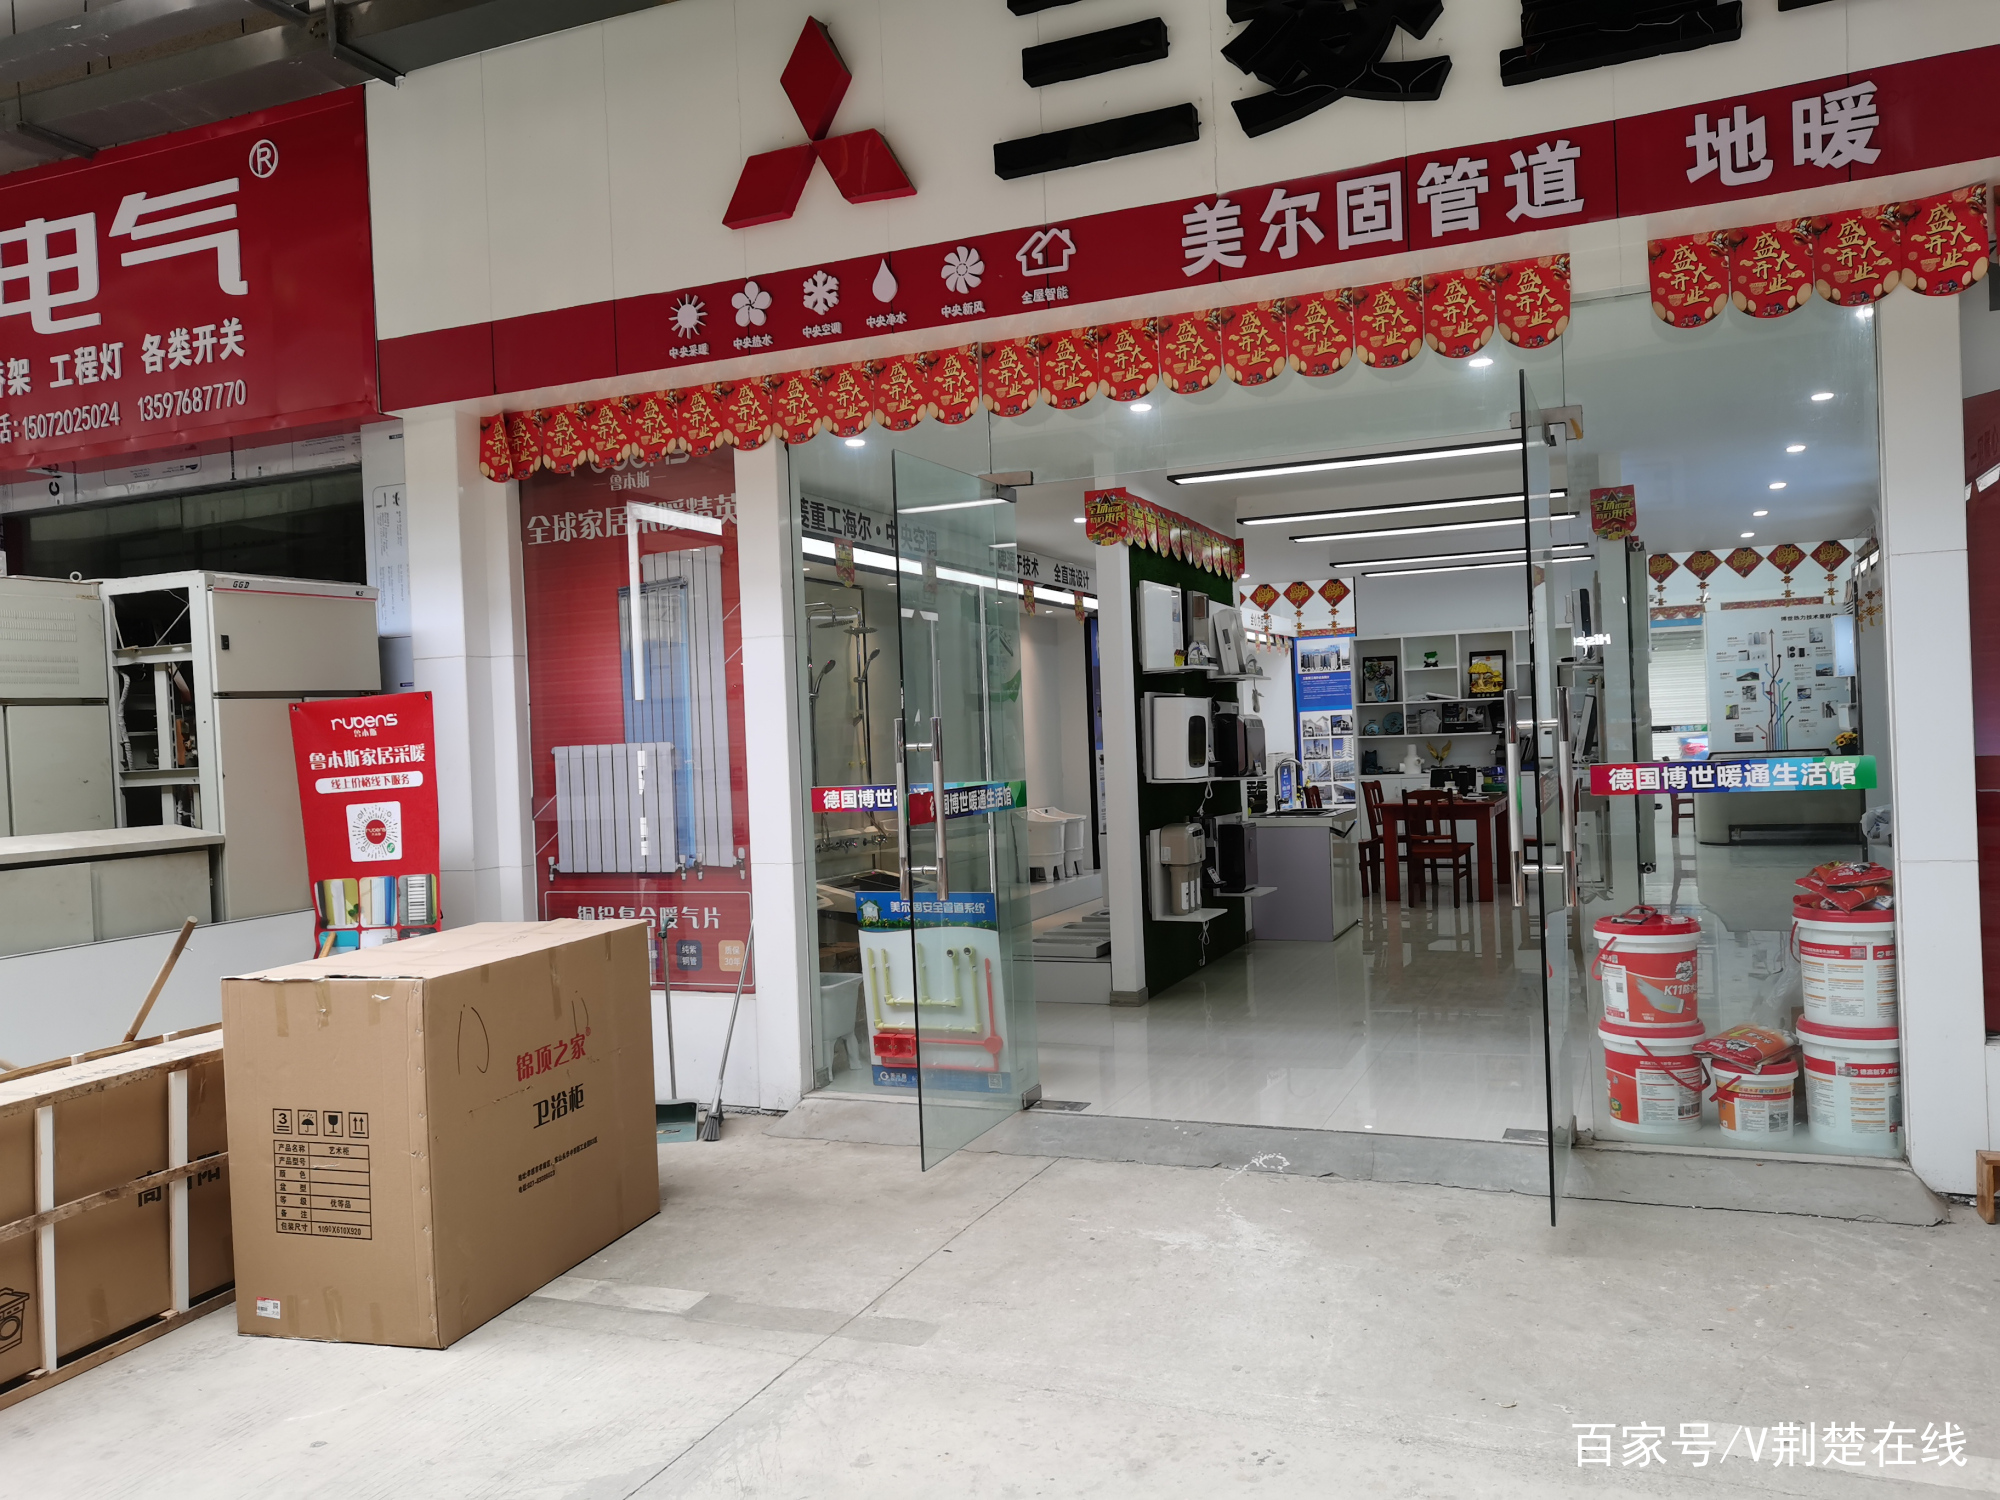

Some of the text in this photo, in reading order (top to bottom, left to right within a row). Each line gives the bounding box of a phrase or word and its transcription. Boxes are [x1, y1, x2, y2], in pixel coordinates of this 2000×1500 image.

[1181, 80, 1882, 276] 美尔固管道 地暖
[0, 177, 249, 336] 电气
[940, 301, 986, 319] 中央新风
[1021, 285, 1070, 305] 全屋智能
[49, 341, 125, 389] 工程灯
[140, 316, 246, 375] 各类开关
[137, 378, 247, 422] 13597687770
[1053, 563, 1090, 590] 全直流设计
[308, 743, 426, 771] 鲁本斯家居采暖
[1608, 760, 1857, 792] 德国博世暖通生活馆
[330, 774, 411, 791] 线上价格线下服务
[516, 1032, 587, 1083] 锦顶之家
[532, 1082, 585, 1130] 卫浴柜
